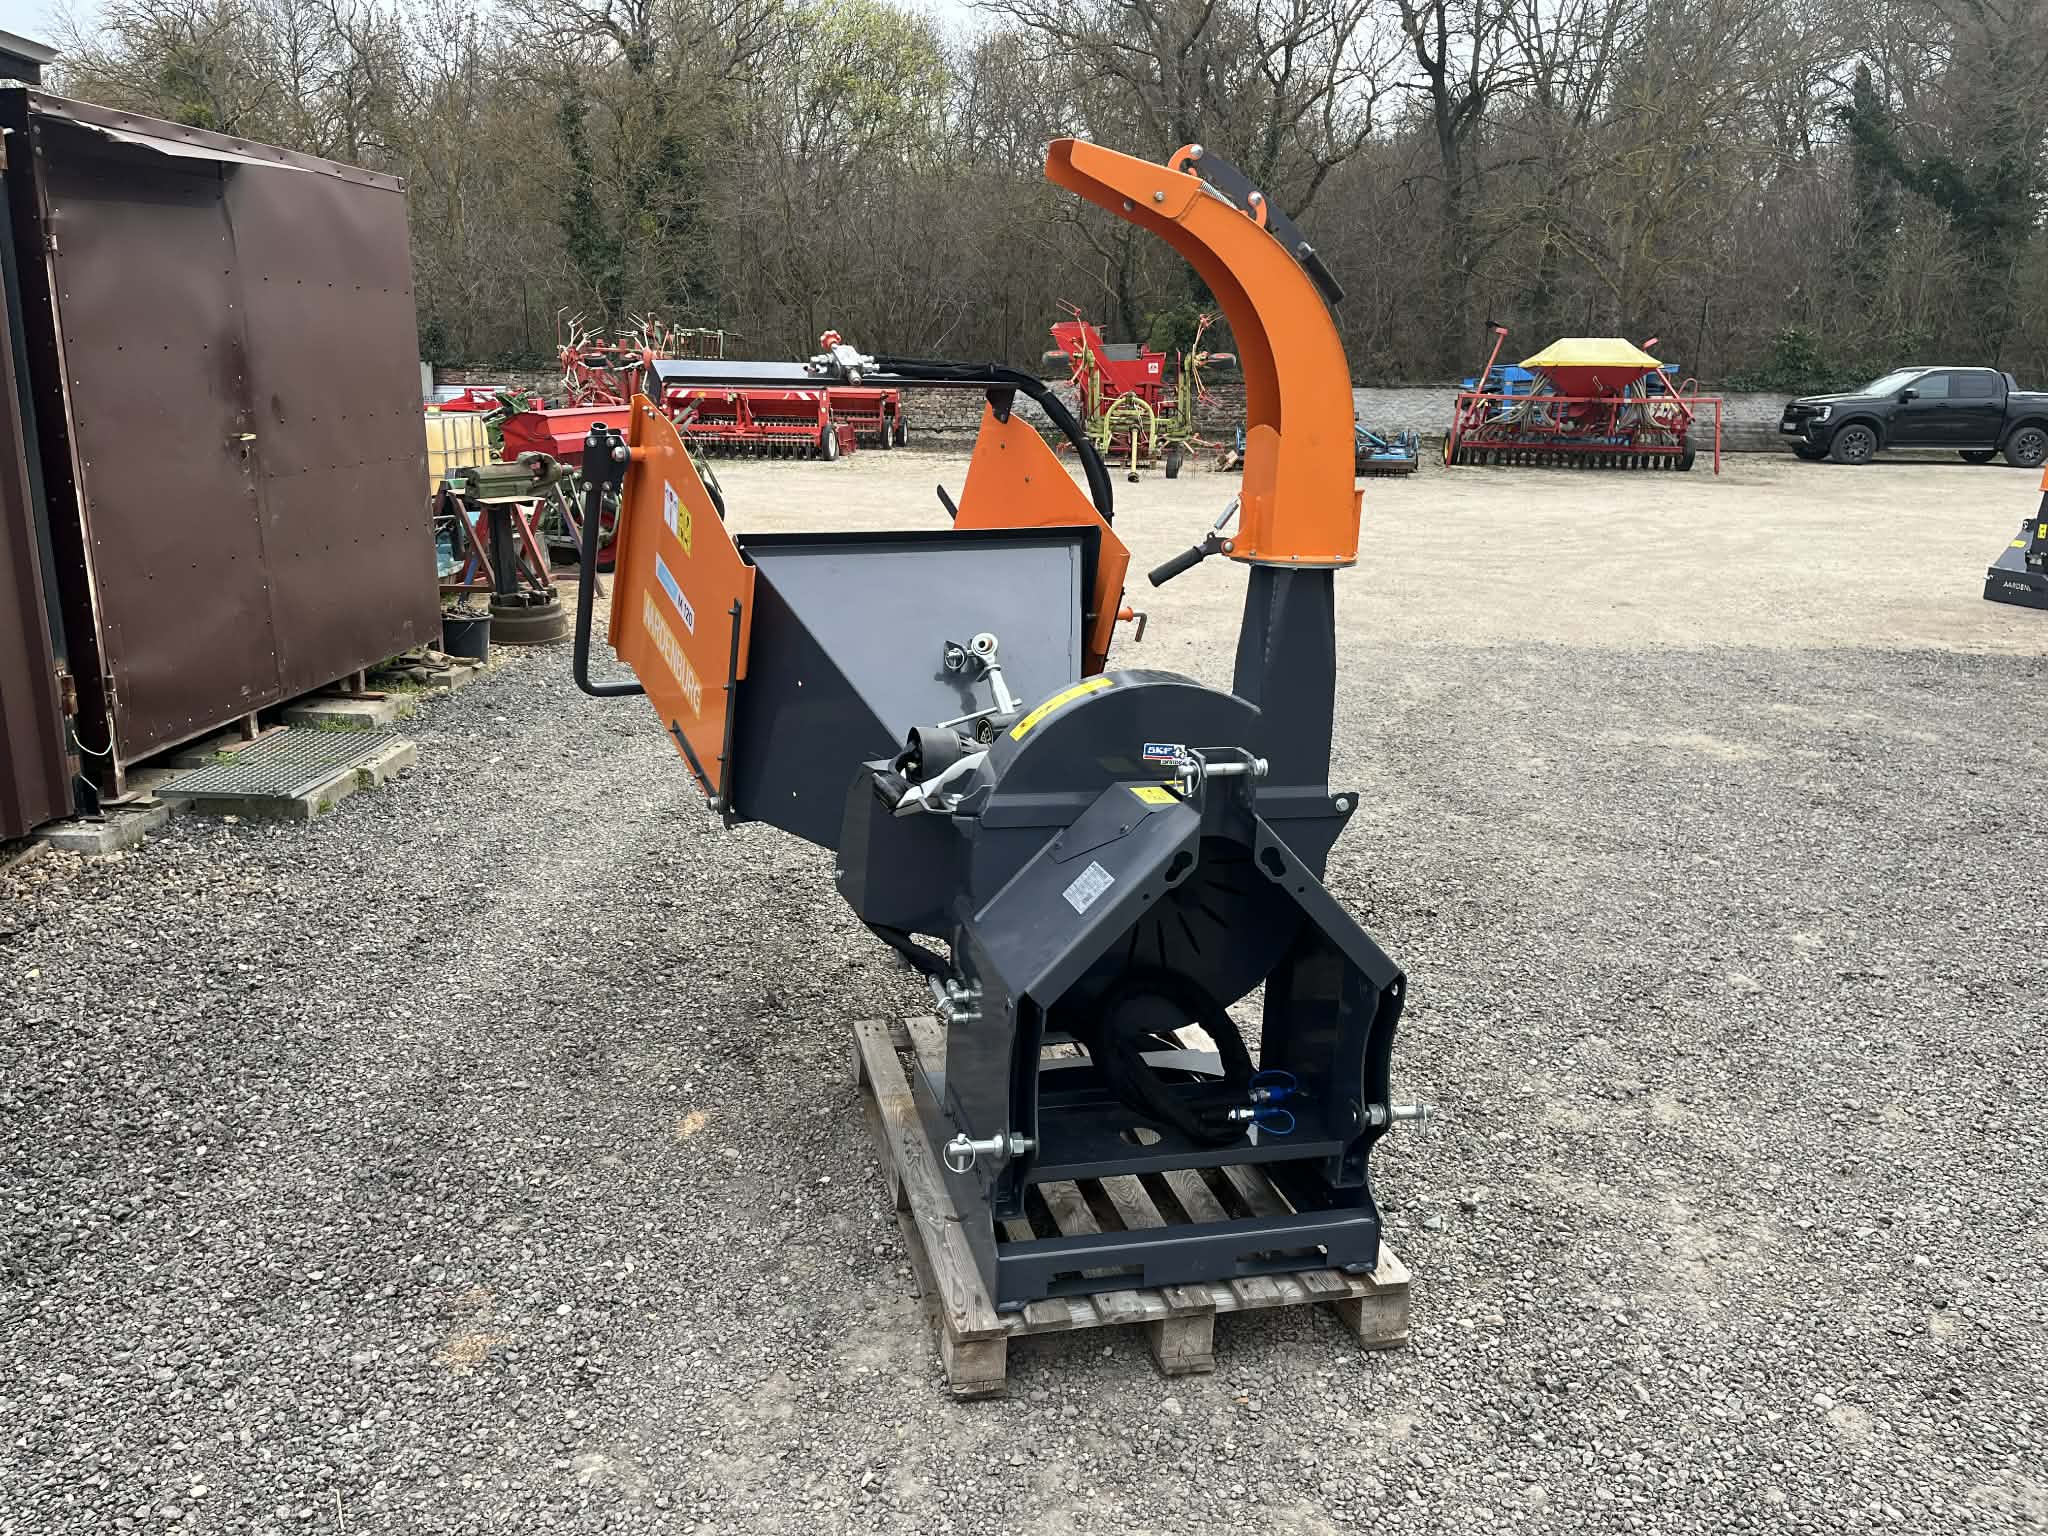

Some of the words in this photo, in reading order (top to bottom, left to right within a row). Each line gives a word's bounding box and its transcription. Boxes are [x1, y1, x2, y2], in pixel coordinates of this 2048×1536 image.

[677, 592, 683, 612] M
[683, 603, 693, 627] 120
[643, 596, 702, 716] AARDENBURG
[1147, 746, 1173, 755] SKF
